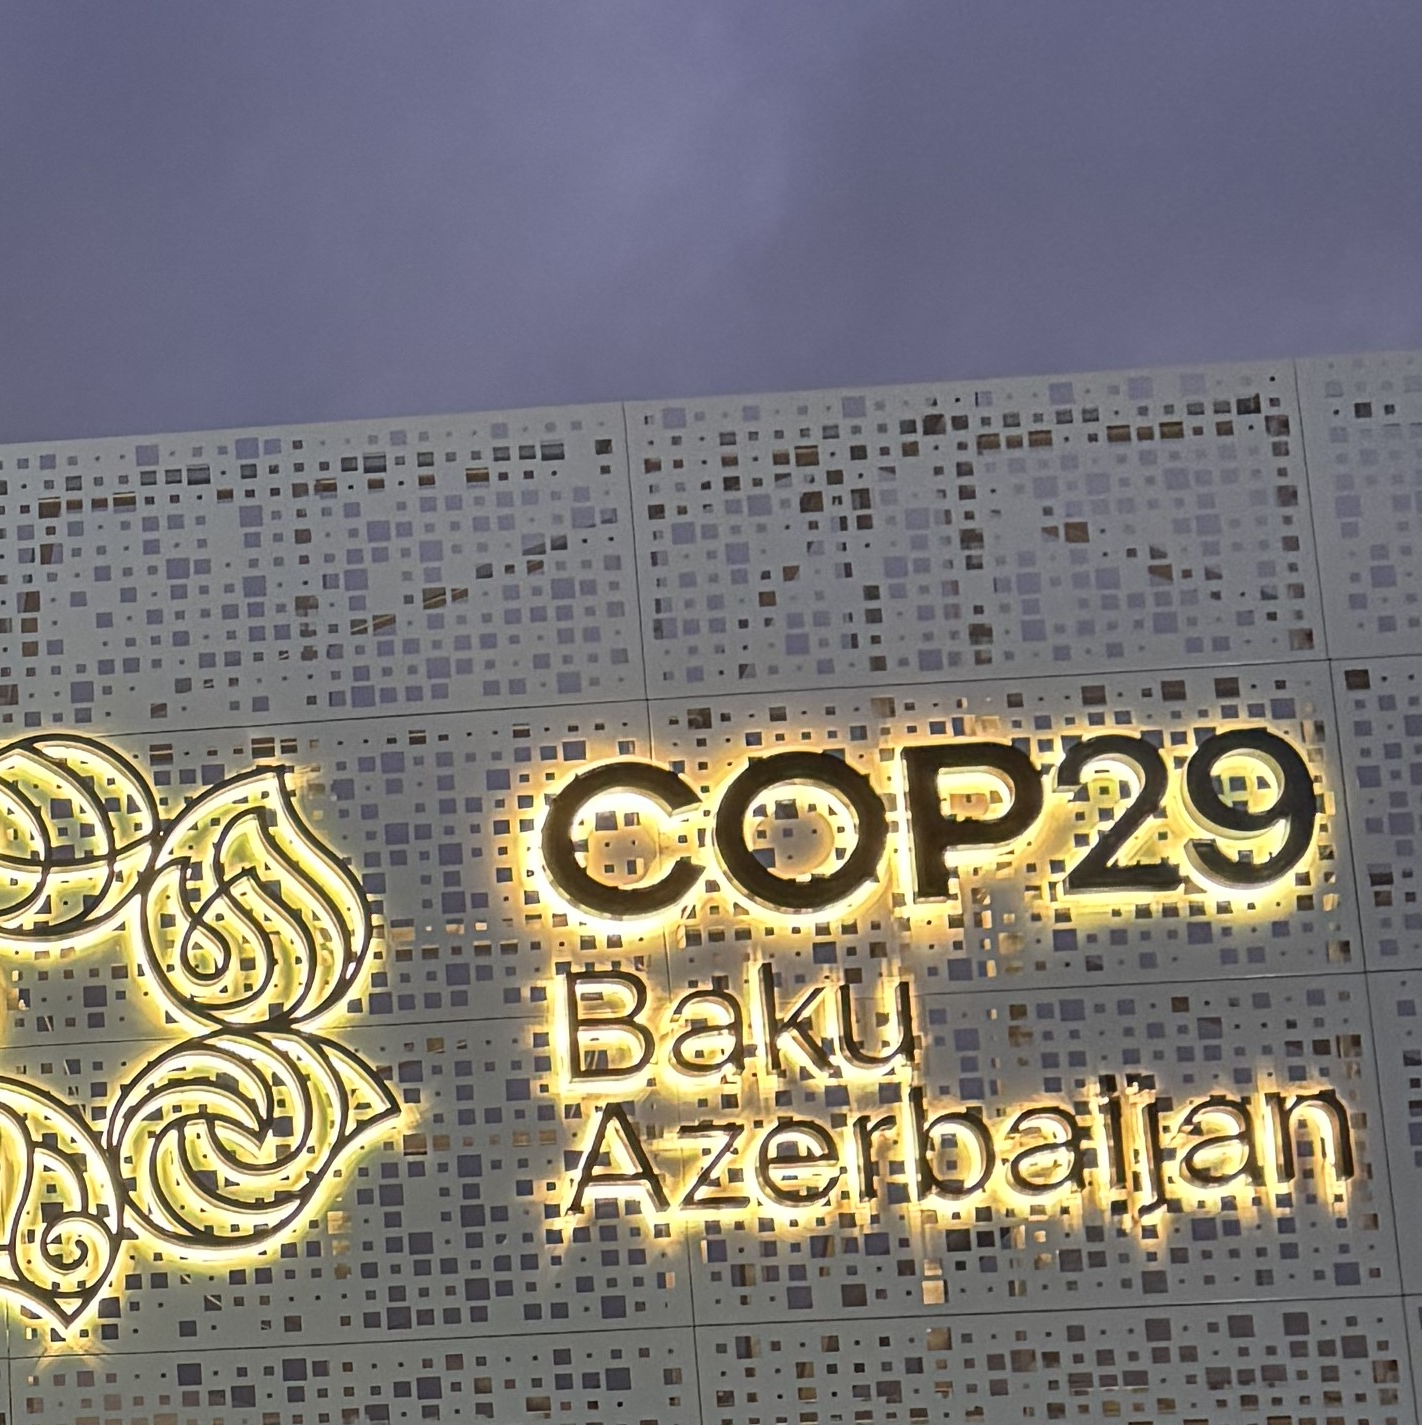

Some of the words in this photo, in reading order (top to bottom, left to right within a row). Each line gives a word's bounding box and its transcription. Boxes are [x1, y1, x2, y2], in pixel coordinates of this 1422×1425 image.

[540, 727, 1319, 920] COP29
[566, 961, 915, 1084] Baku
[564, 1074, 1354, 1215] Azerbaijan
